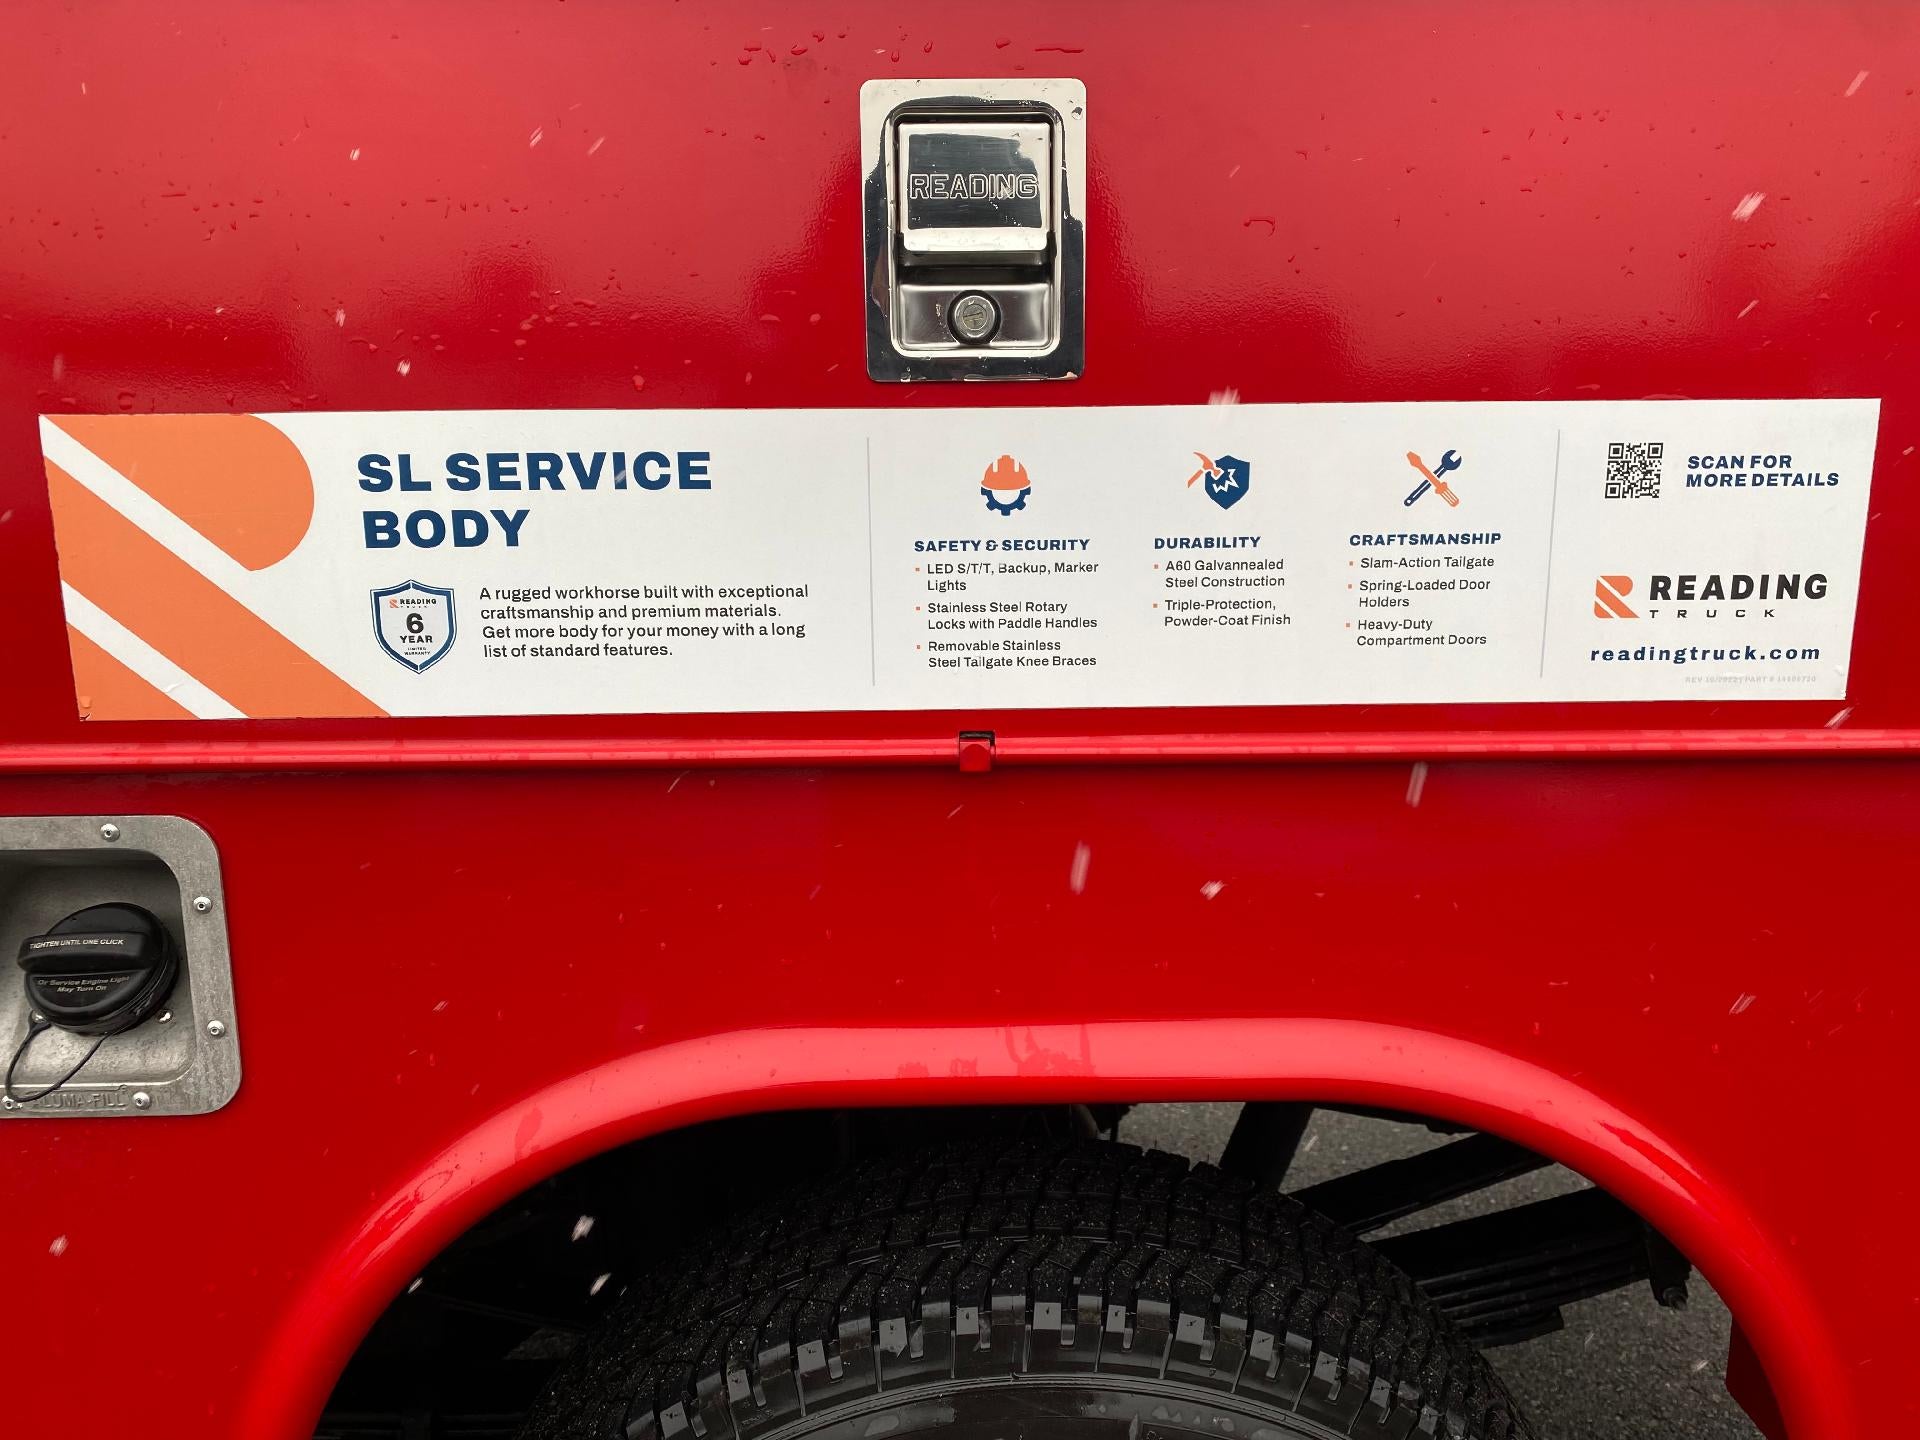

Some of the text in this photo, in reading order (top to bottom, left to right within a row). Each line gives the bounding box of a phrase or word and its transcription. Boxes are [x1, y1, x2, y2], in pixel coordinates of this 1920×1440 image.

[910, 174, 1039, 199] READING
[1687, 454, 1793, 469] SCAN FOR
[357, 451, 712, 492] SL SERVICE
[1685, 472, 1839, 488] MORE DETAILS
[363, 509, 531, 549] BODY
[914, 539, 1090, 552] SAFETY & SECURITY
[1154, 536, 1261, 549] DURABILITY
[1349, 533, 1502, 546] CRAFTSMANSHIP
[927, 562, 1099, 576] LED S/T/T, Backup, Marker
[1165, 559, 1284, 571] A60 Galvannealed
[1360, 556, 1495, 569] Slam-Action Tailgate
[927, 580, 967, 592] Lights
[1165, 576, 1286, 588] Steel Construction
[1359, 579, 1491, 593] Spring-Loaded Door
[1649, 574, 1828, 600] READING
[480, 584, 809, 602] A rugged workhorse built with exceptional
[928, 601, 1068, 614] Stainless Steel Rotary
[1164, 599, 1277, 612] Triple-Protection,
[1359, 596, 1410, 607] Holders
[480, 604, 782, 621] craftsmanship and premium materials.
[1650, 609, 1775, 618] TRUCK
[406, 613, 424, 634] 6
[928, 617, 1098, 630] Locks with Paddle Handles
[1164, 614, 1291, 627] Powder-Coat Finish
[1358, 619, 1433, 632] Heavy-Duty
[482, 622, 806, 640] Get more body for your money with a long
[400, 635, 433, 643] YEAR
[1357, 634, 1487, 648] Compartment Doors
[484, 642, 673, 657] list of standard features.
[928, 640, 1062, 652] Removable Stainless
[1590, 646, 1820, 664] readingtruck.com
[928, 656, 1098, 670] Steel Tailgate Knee Braces
[30, 940, 60, 949] TIGHTEN
